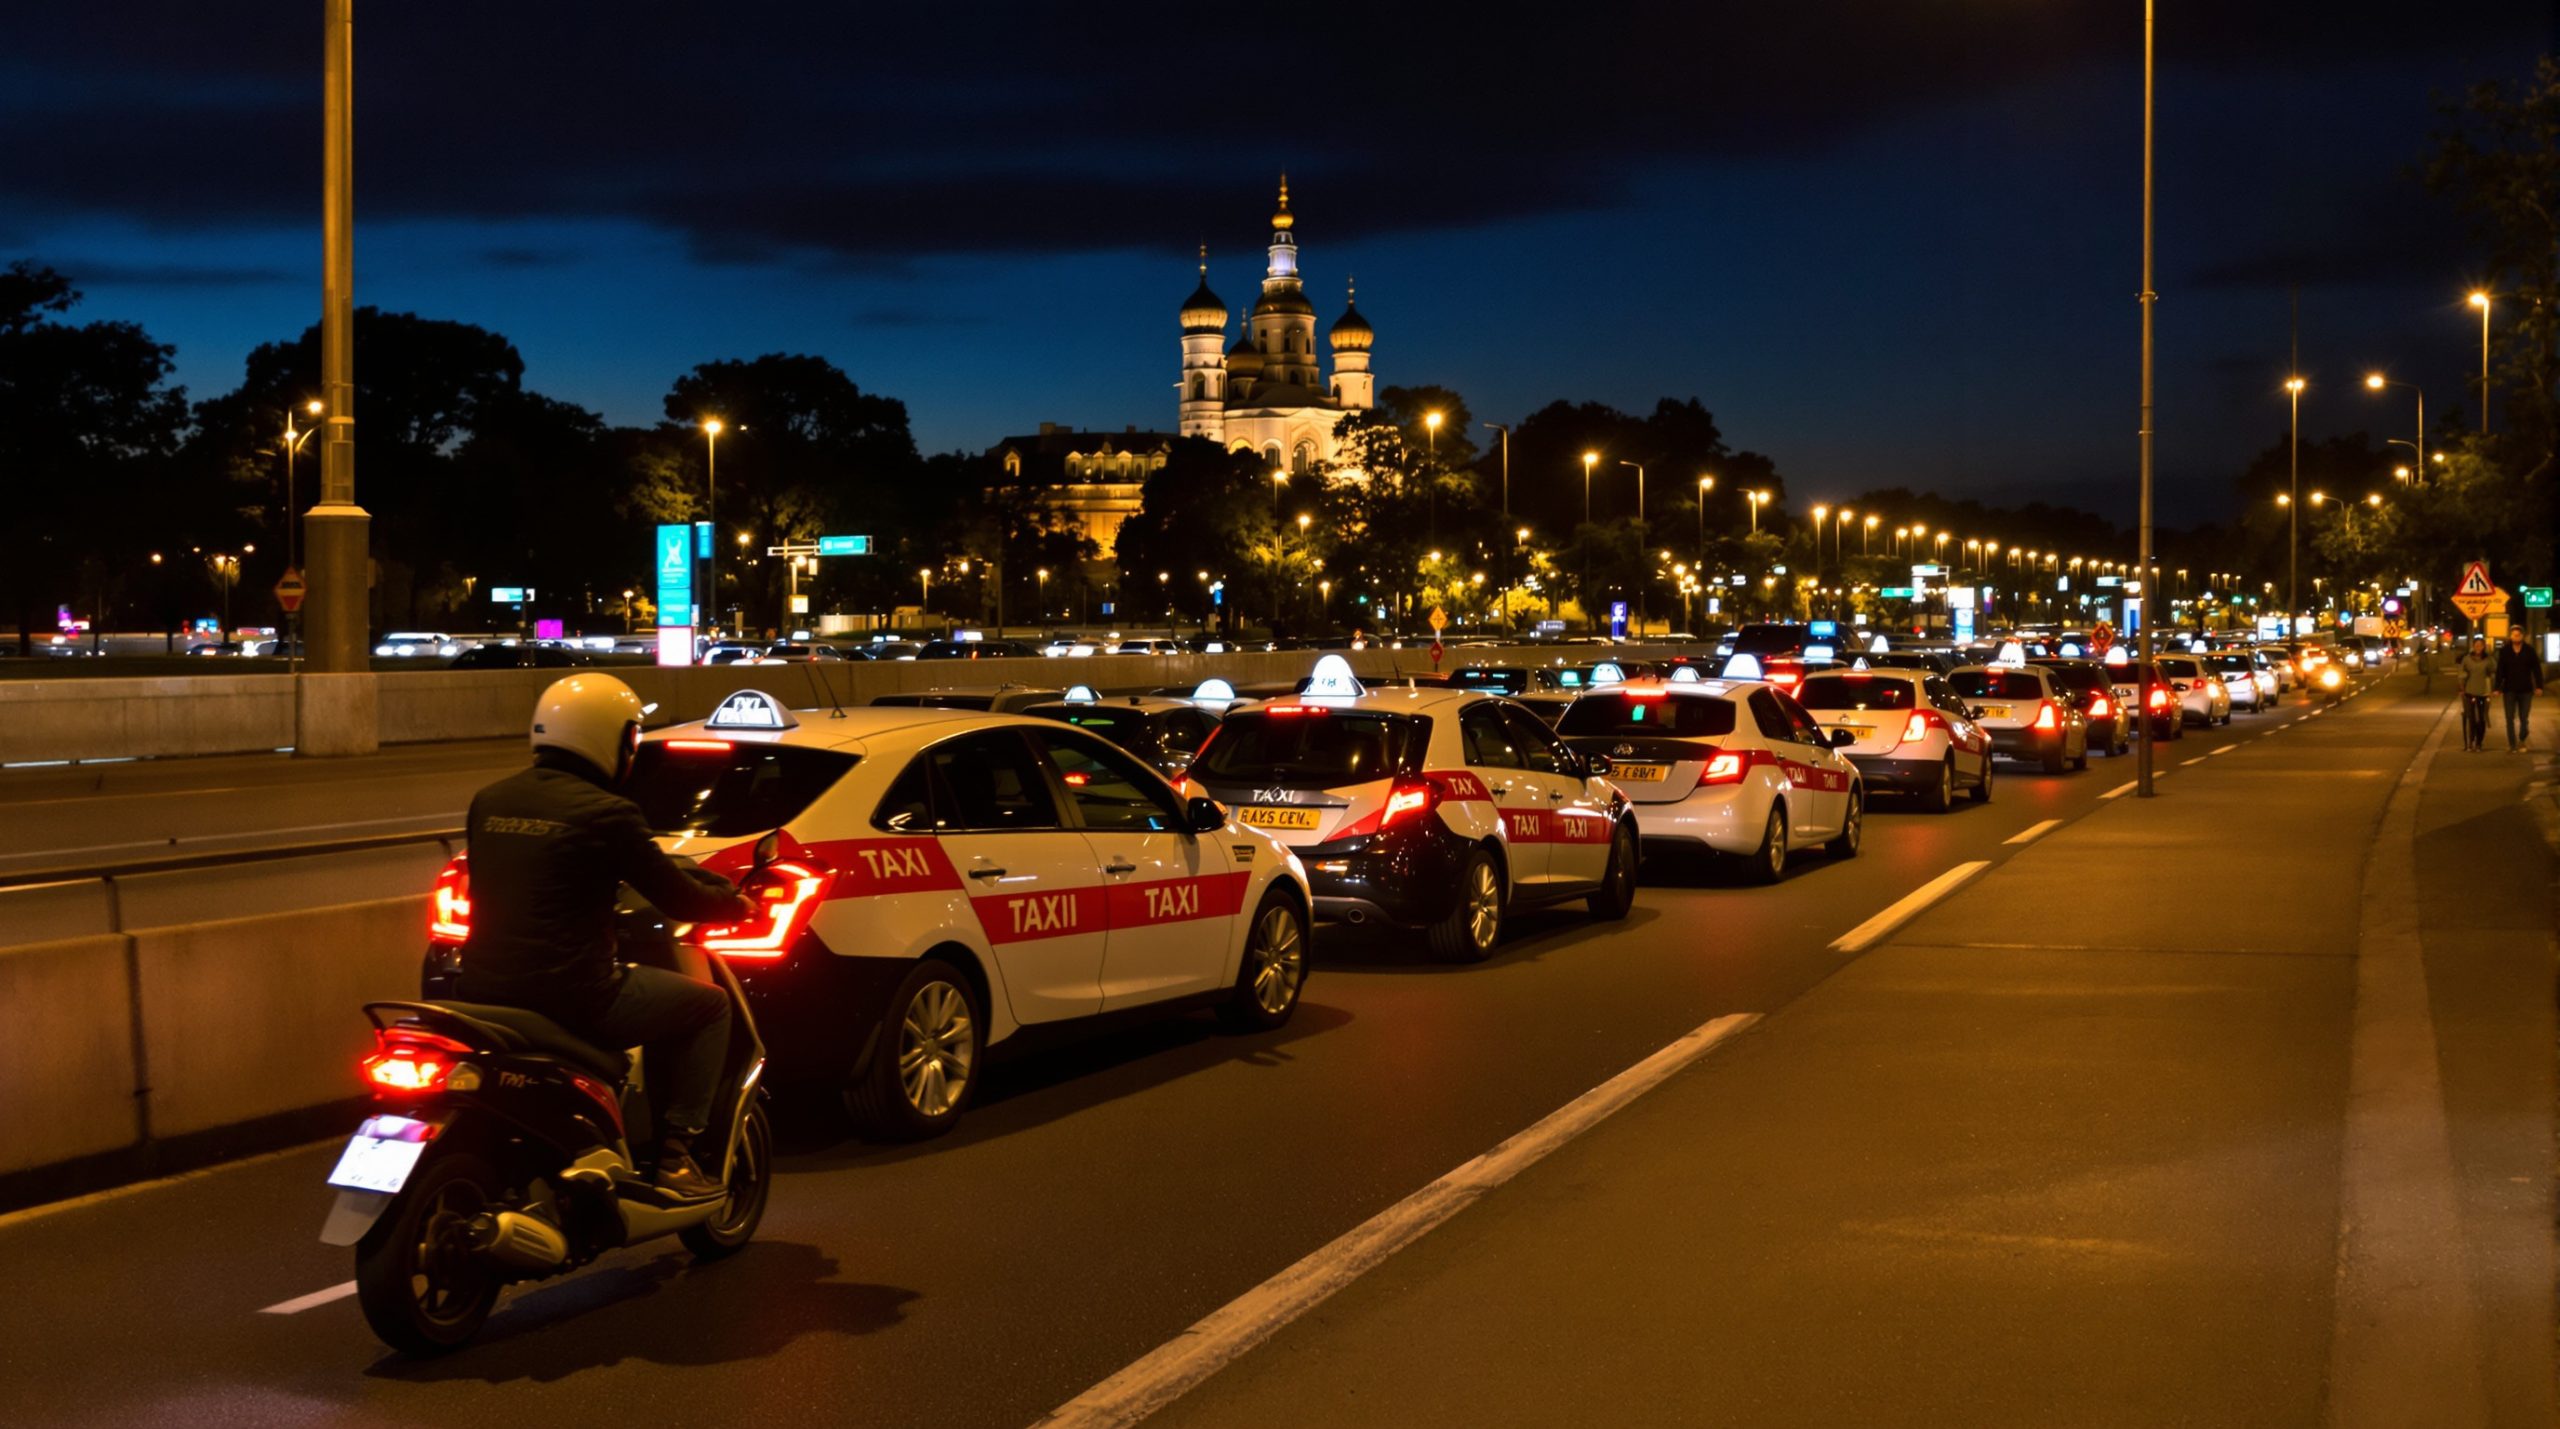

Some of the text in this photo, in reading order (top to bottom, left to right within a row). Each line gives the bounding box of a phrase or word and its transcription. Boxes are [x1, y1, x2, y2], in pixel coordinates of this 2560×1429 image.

[1513, 815, 1540, 836] TAXI
[1563, 818, 1588, 838] TAXI
[858, 847, 931, 879] TAXI
[1008, 894, 1077, 933] TAXII
[1145, 884, 1199, 918] TAXI
